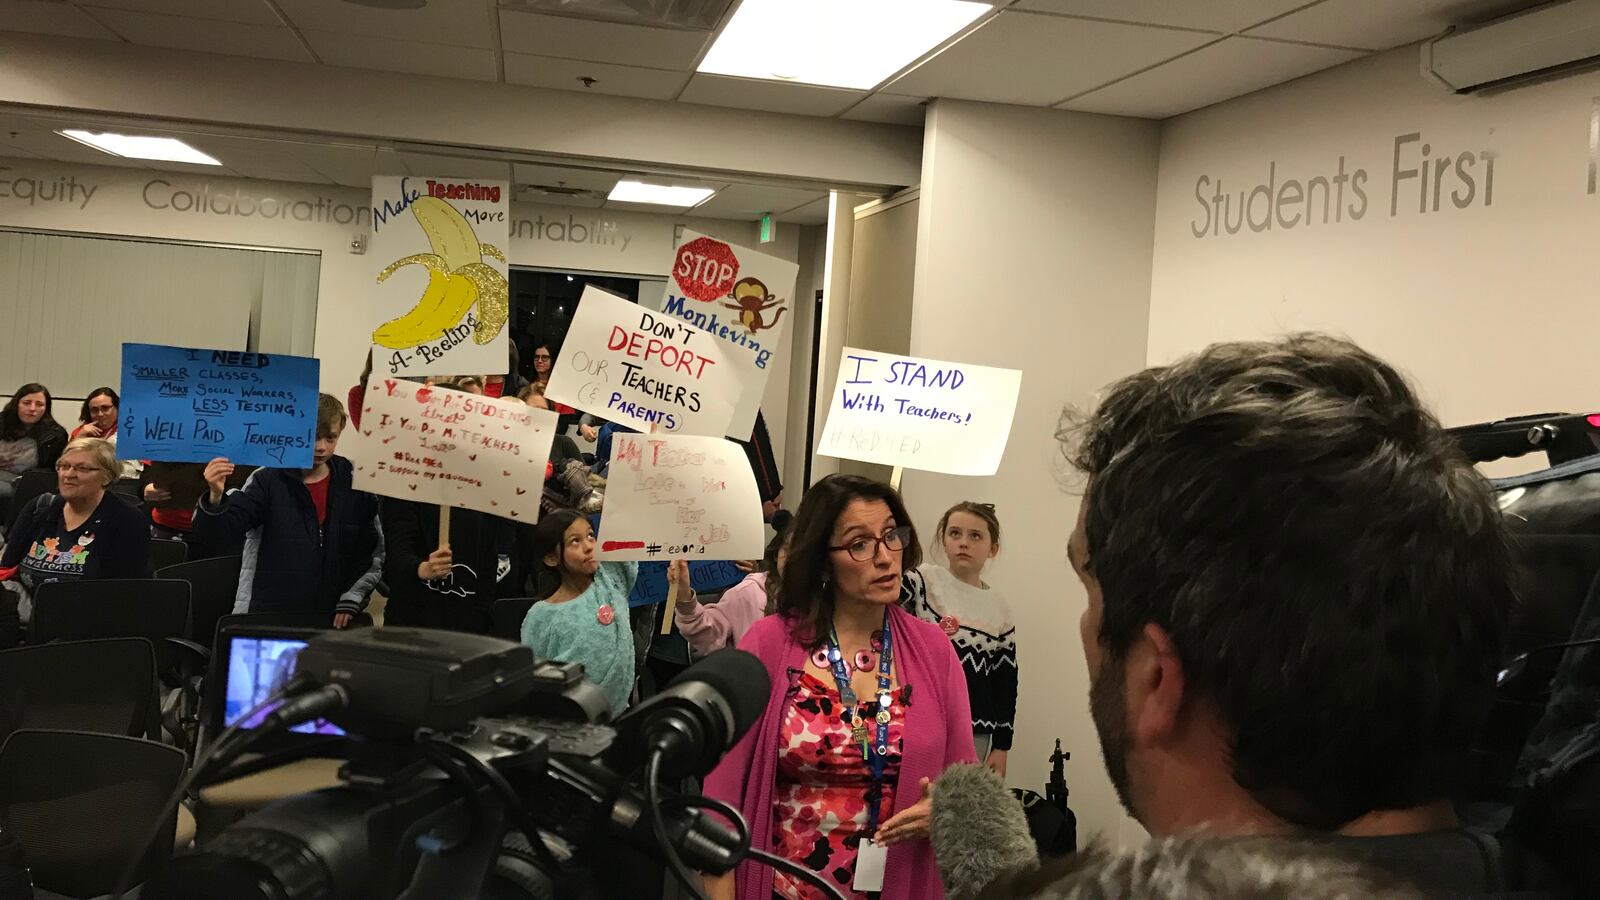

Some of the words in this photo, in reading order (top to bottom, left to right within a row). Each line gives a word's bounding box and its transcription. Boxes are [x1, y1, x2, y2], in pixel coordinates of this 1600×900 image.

[142, 179, 371, 226] Collaboration
[1191, 155, 1368, 239] Students
[1390, 131, 1497, 217] First
[374, 177, 420, 232] Make
[426, 180, 500, 203] Teaching
[464, 209, 504, 224] More
[678, 251, 733, 288] STOP
[639, 312, 695, 345] DON'T
[211, 351, 270, 368] NEED
[607, 325, 715, 380] DEPORT
[132, 364, 189, 378] SMALLER
[198, 369, 264, 384] CLASSES,
[571, 350, 609, 382] OUR
[620, 361, 701, 412] TEACHERS
[846, 355, 878, 384] I
[884, 361, 964, 390] STAND
[192, 398, 229, 412] LESS
[235, 399, 305, 418] TESTING,
[842, 389, 884, 413] With
[894, 398, 972, 426] Teachers!
[145, 416, 184, 441] WELL
[193, 419, 225, 443] PAID
[243, 422, 311, 449] TEACHERS!
